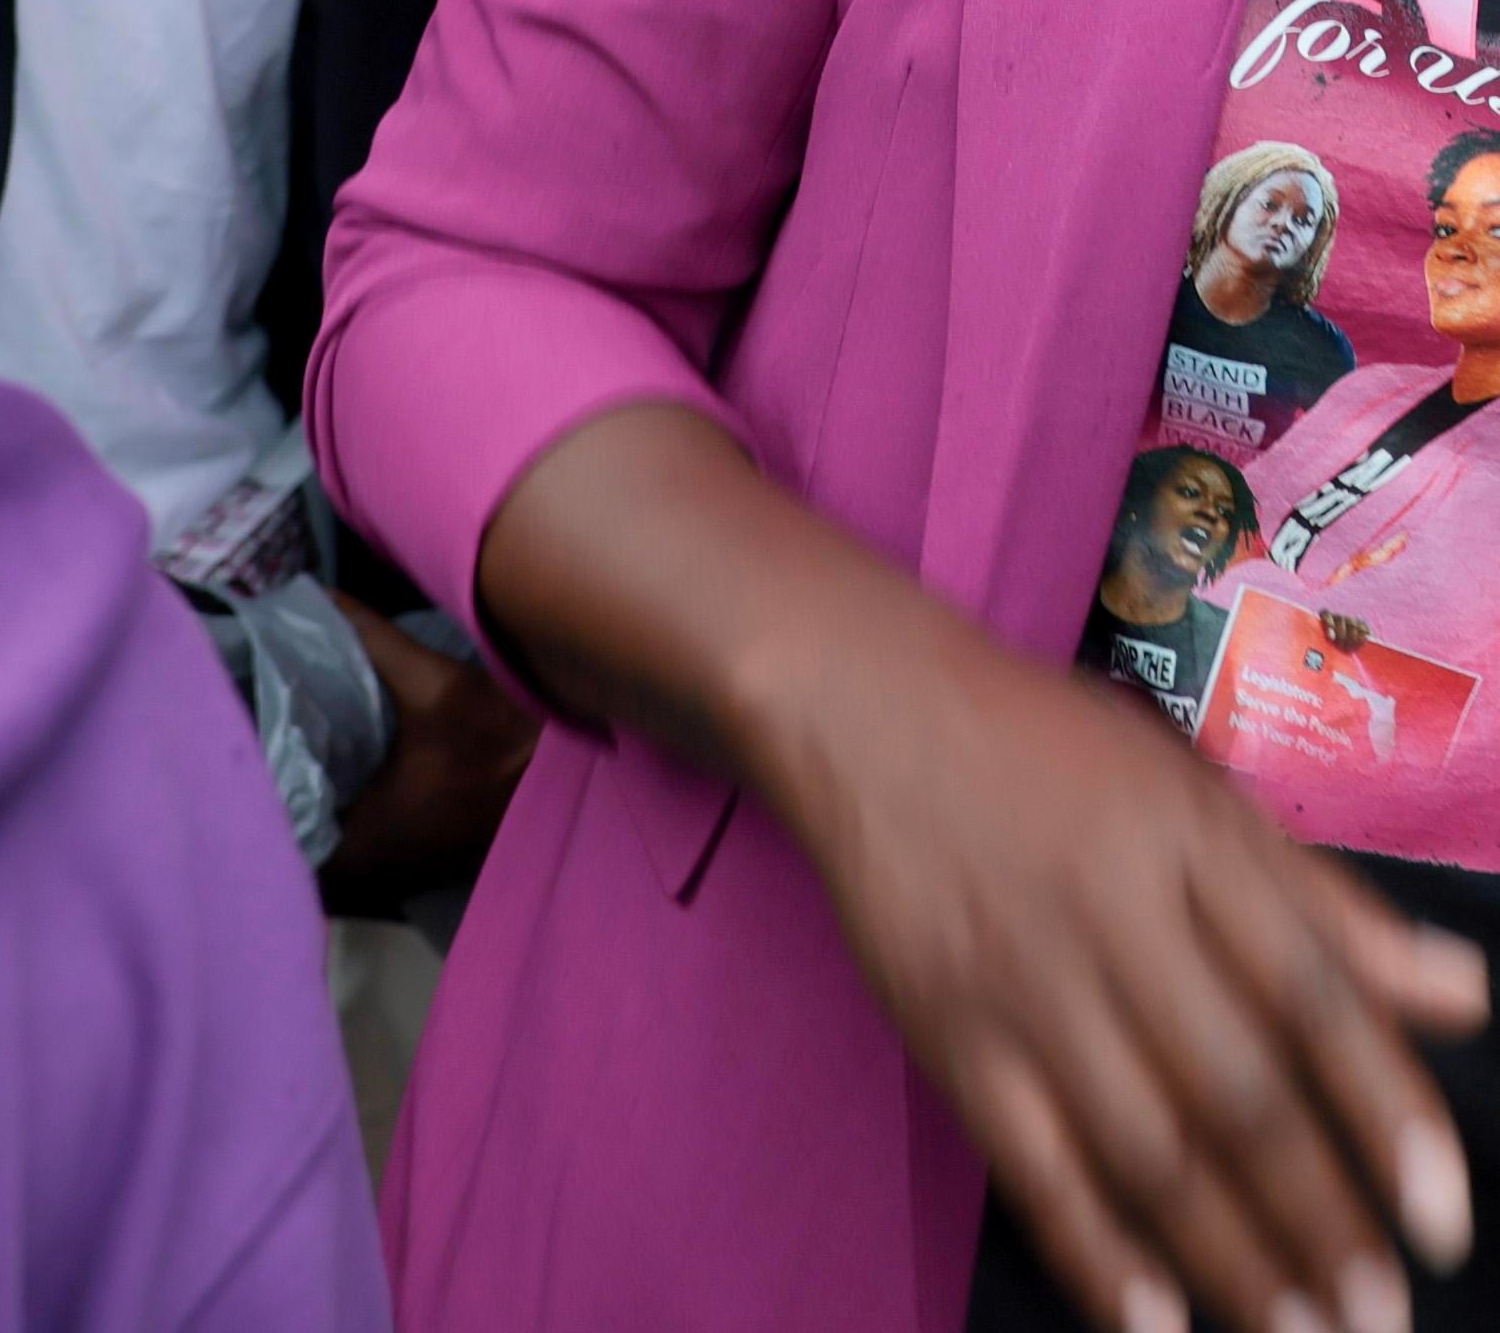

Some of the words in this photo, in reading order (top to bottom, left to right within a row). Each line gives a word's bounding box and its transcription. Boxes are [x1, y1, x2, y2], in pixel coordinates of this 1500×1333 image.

[1172, 350, 1260, 388] STAND
[1171, 373, 1244, 412] WITH
[1168, 399, 1258, 444] BLACK
[1141, 649, 1173, 684] THE
